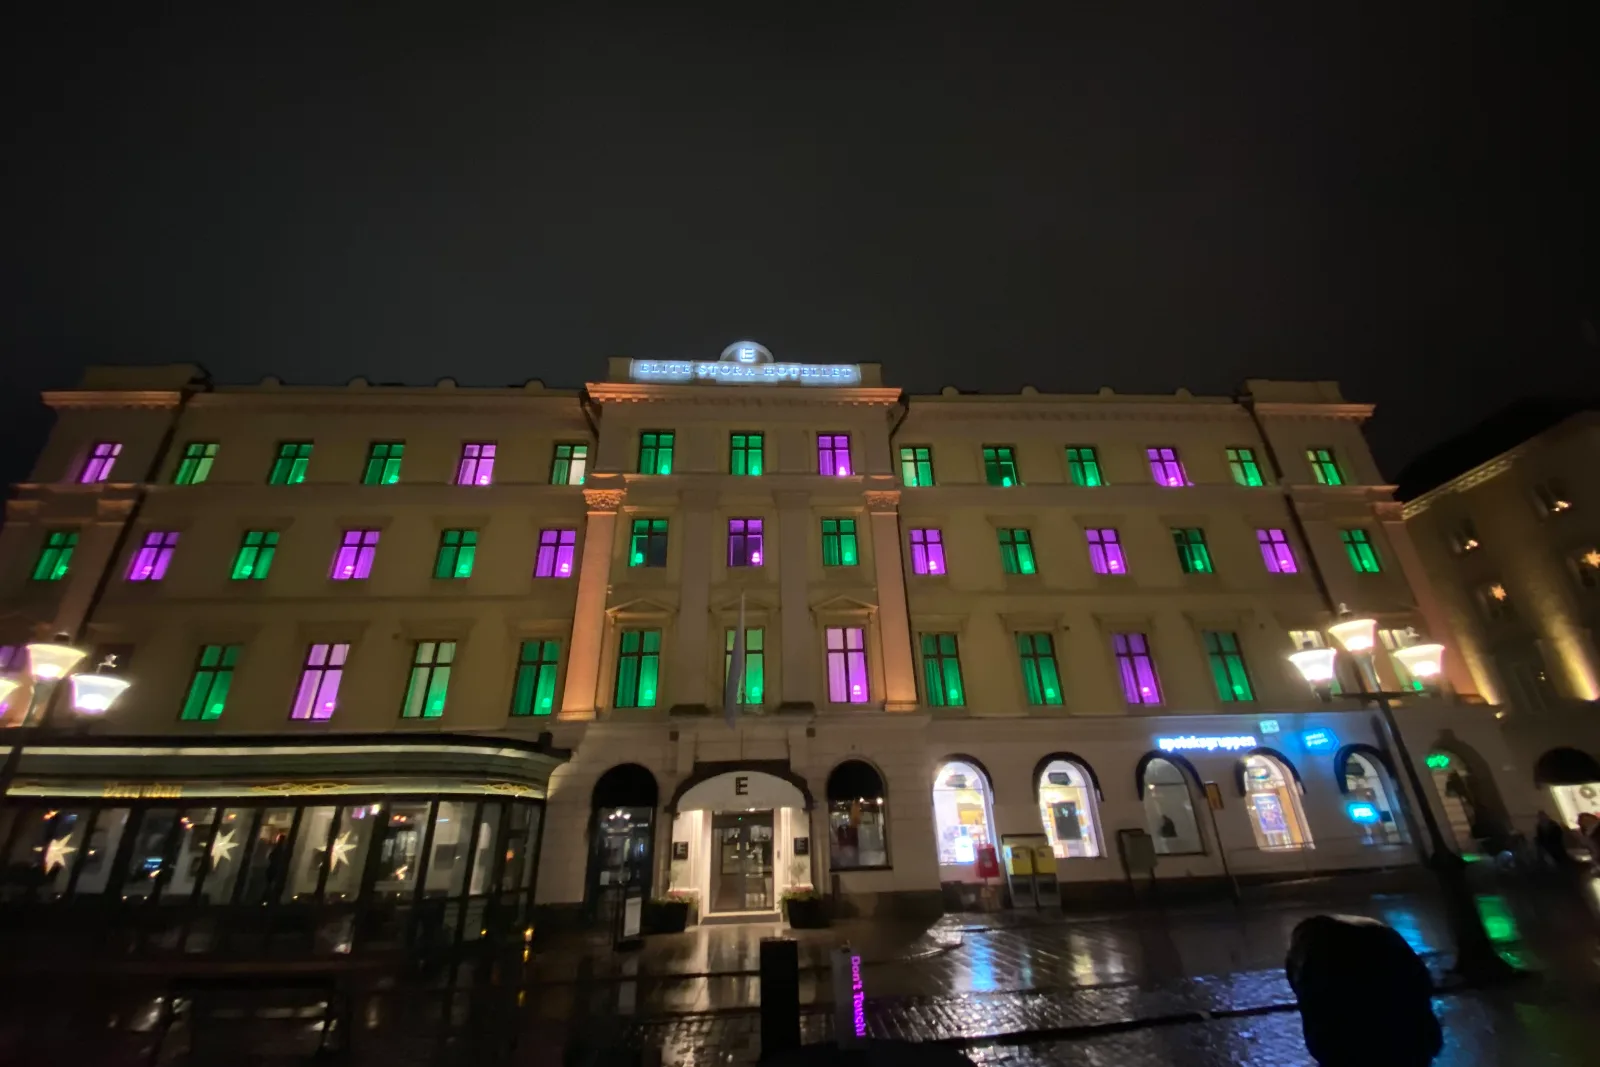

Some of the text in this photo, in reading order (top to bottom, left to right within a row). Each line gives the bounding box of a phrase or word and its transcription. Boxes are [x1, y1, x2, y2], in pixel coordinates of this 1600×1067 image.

[740, 348, 756, 363] E
[640, 363, 852, 378] ELITE STORA HOTELLET
[735, 776, 749, 796] E
[851, 956, 866, 1037] Don't Touch!
